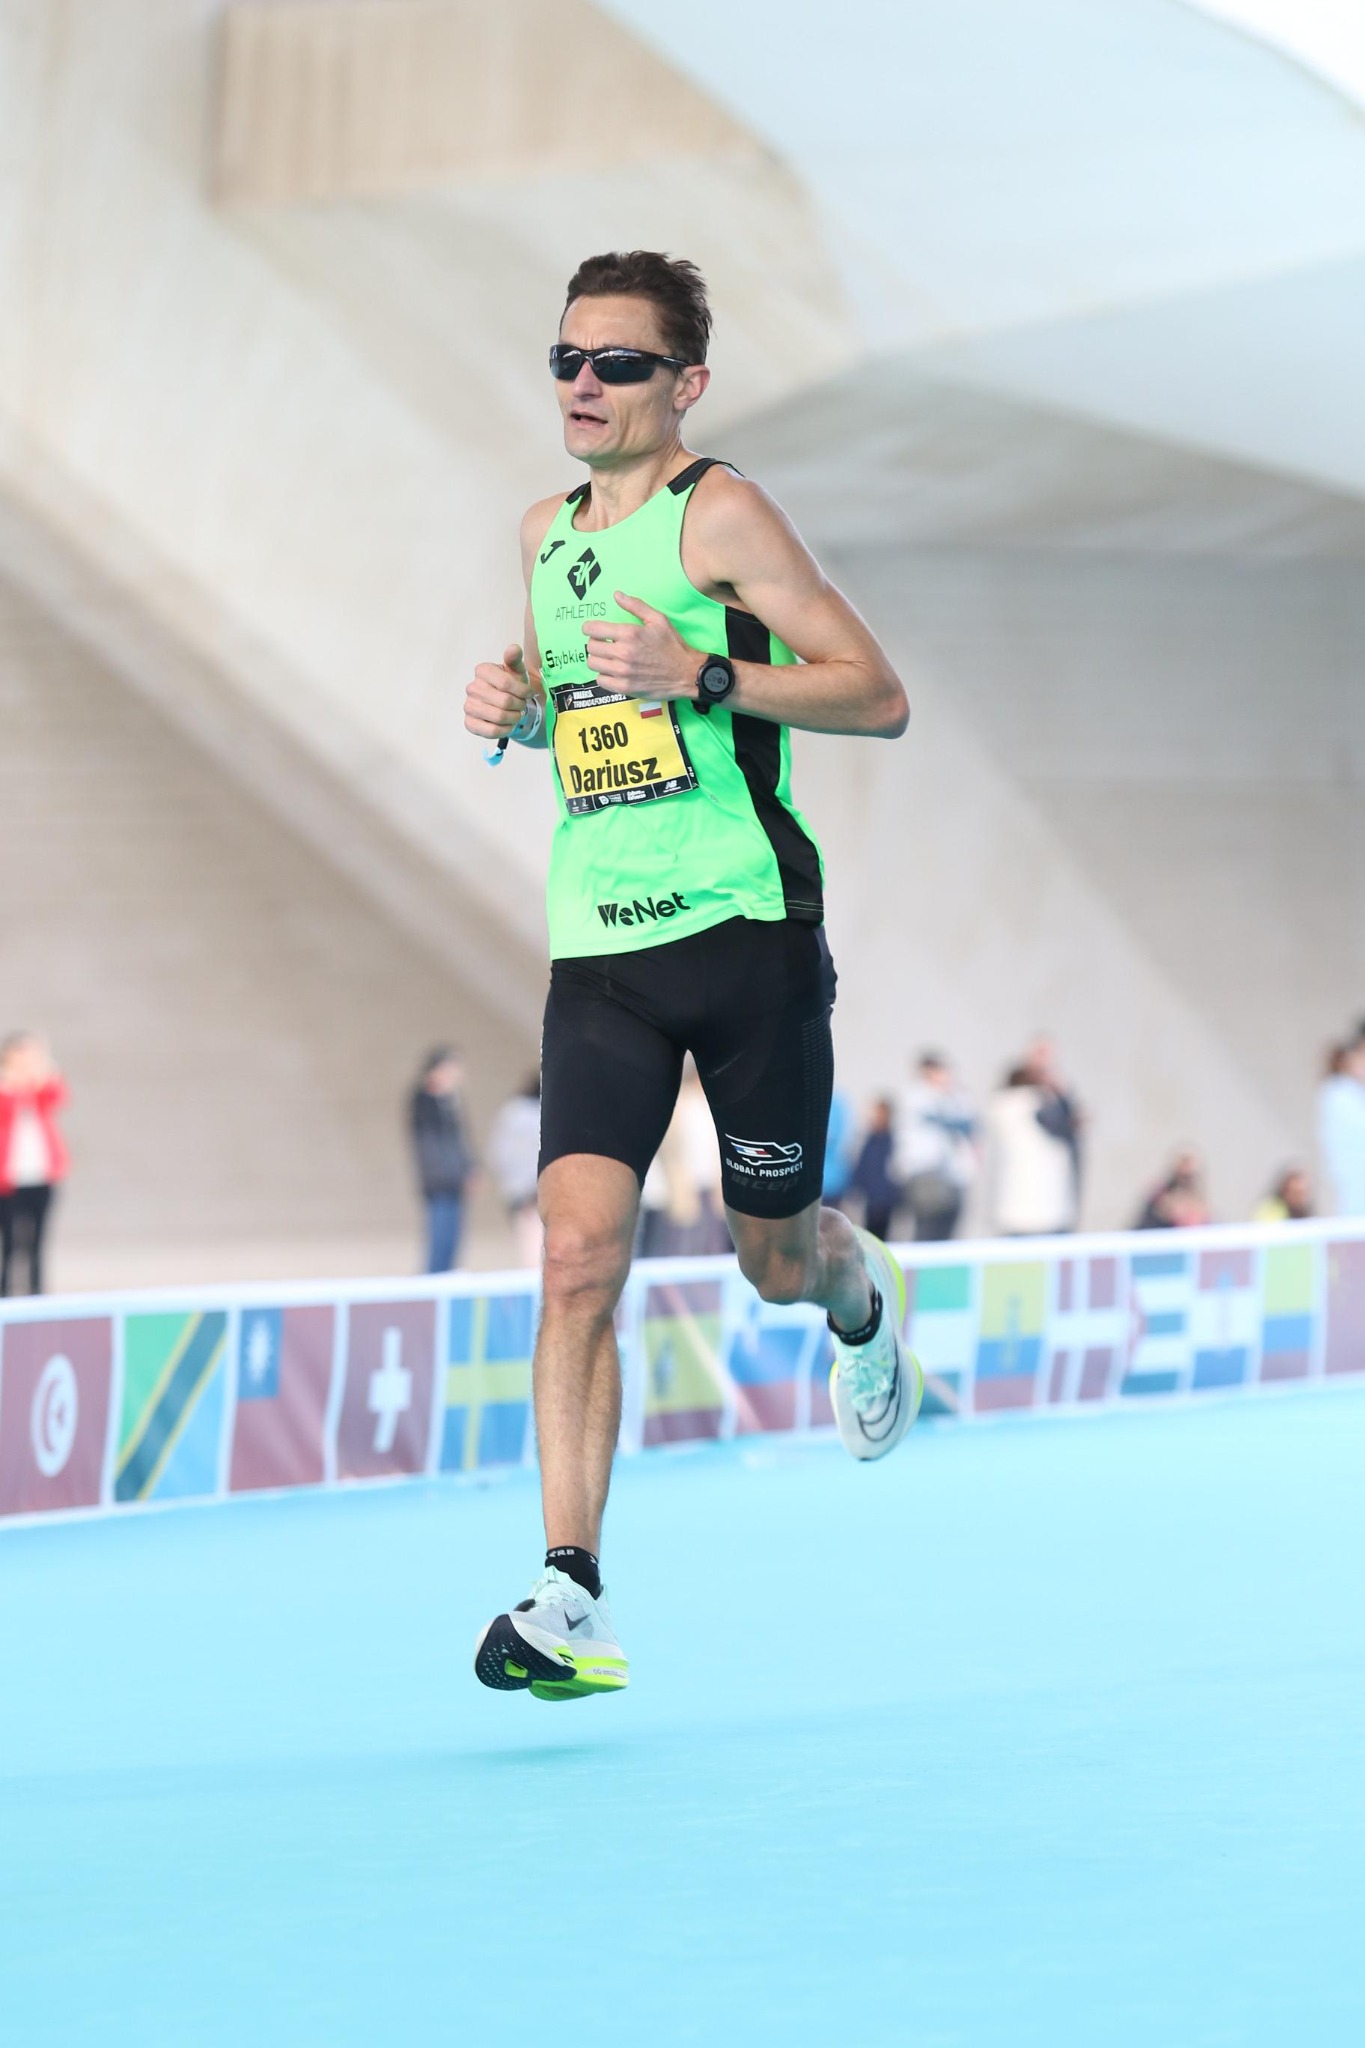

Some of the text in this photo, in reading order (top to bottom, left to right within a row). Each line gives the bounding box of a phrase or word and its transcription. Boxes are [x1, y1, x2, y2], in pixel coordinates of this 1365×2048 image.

[555, 602, 606, 621] ATHLETICS
[545, 644, 591, 669] Szybkie
[578, 722, 629, 753] 1360
[569, 757, 662, 794] Dariusz
[597, 892, 691, 928] WeNet
[726, 1158, 803, 1177] GLOBAL PROSPECT
